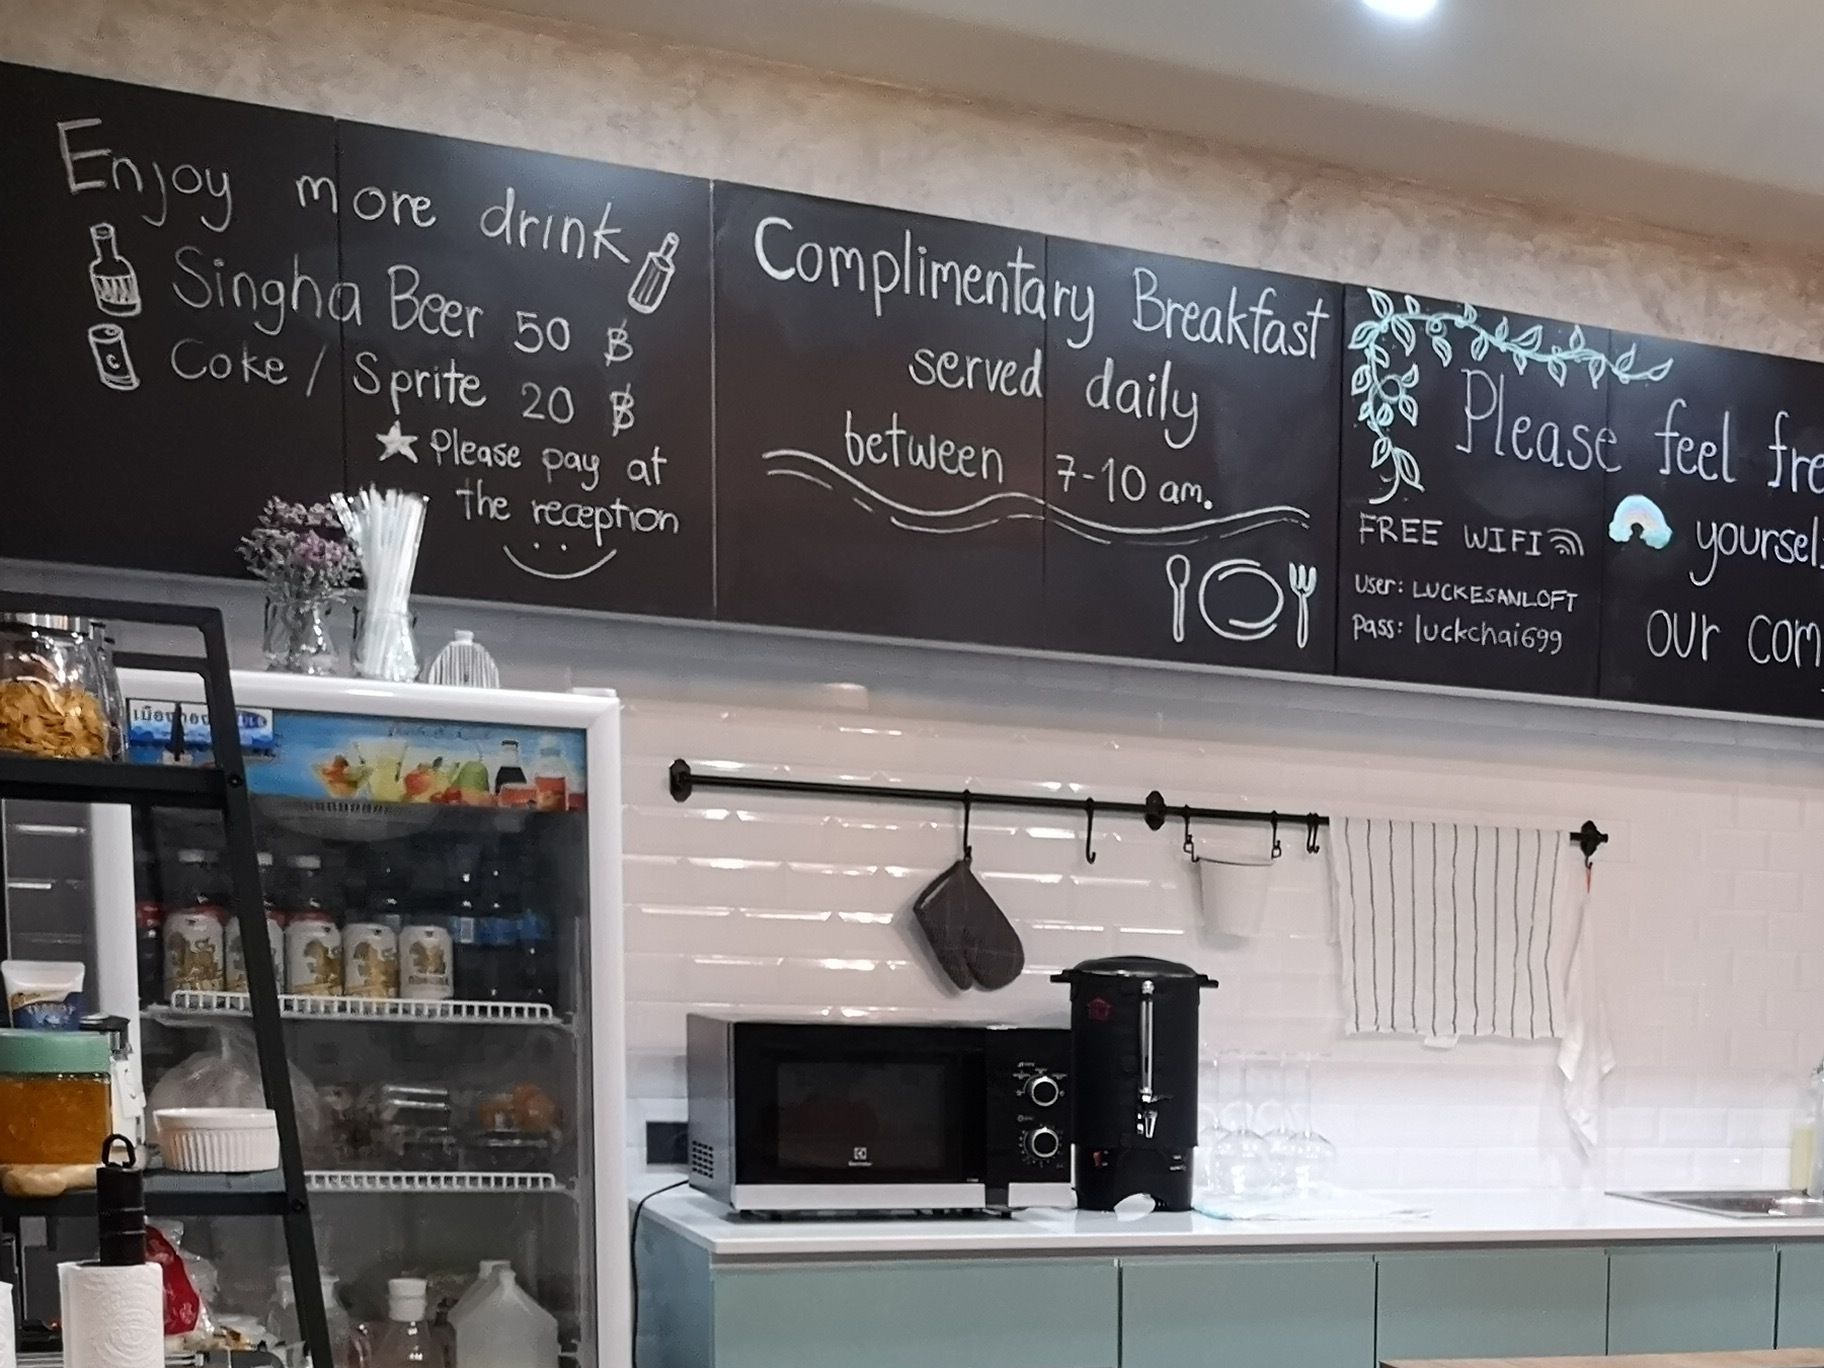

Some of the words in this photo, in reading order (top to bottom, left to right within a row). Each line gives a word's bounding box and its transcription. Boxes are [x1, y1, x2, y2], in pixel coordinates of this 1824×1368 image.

[56, 117, 232, 231] Enjoy
[296, 175, 437, 227] more
[481, 188, 629, 264] drink
[172, 246, 362, 336] Singha
[388, 265, 484, 339] Beer
[514, 310, 571, 354] 50
[754, 216, 1095, 349] Complimentary
[1132, 268, 1330, 359] Breakfast
[170, 338, 288, 385] Coke
[354, 351, 486, 415] Sprite
[521, 383, 575, 424] 20
[909, 348, 1043, 399] served
[1086, 357, 1199, 449] daily
[429, 428, 522, 468] Please
[542, 448, 601, 491] pay
[626, 446, 667, 487] at
[845, 410, 1004, 484] between
[1456, 369, 1622, 472] Please
[1655, 398, 1736, 483] feel
[455, 479, 511, 523] the
[531, 487, 680, 547] reception
[1359, 512, 1443, 545] FREE
[1464, 525, 1543, 556] WIFI
[1355, 574, 1403, 594] User:
[1413, 581, 1578, 612] LUCKESANLOFT
[1415, 613, 1563, 655] luckchai699
[1647, 610, 1720, 660] our
